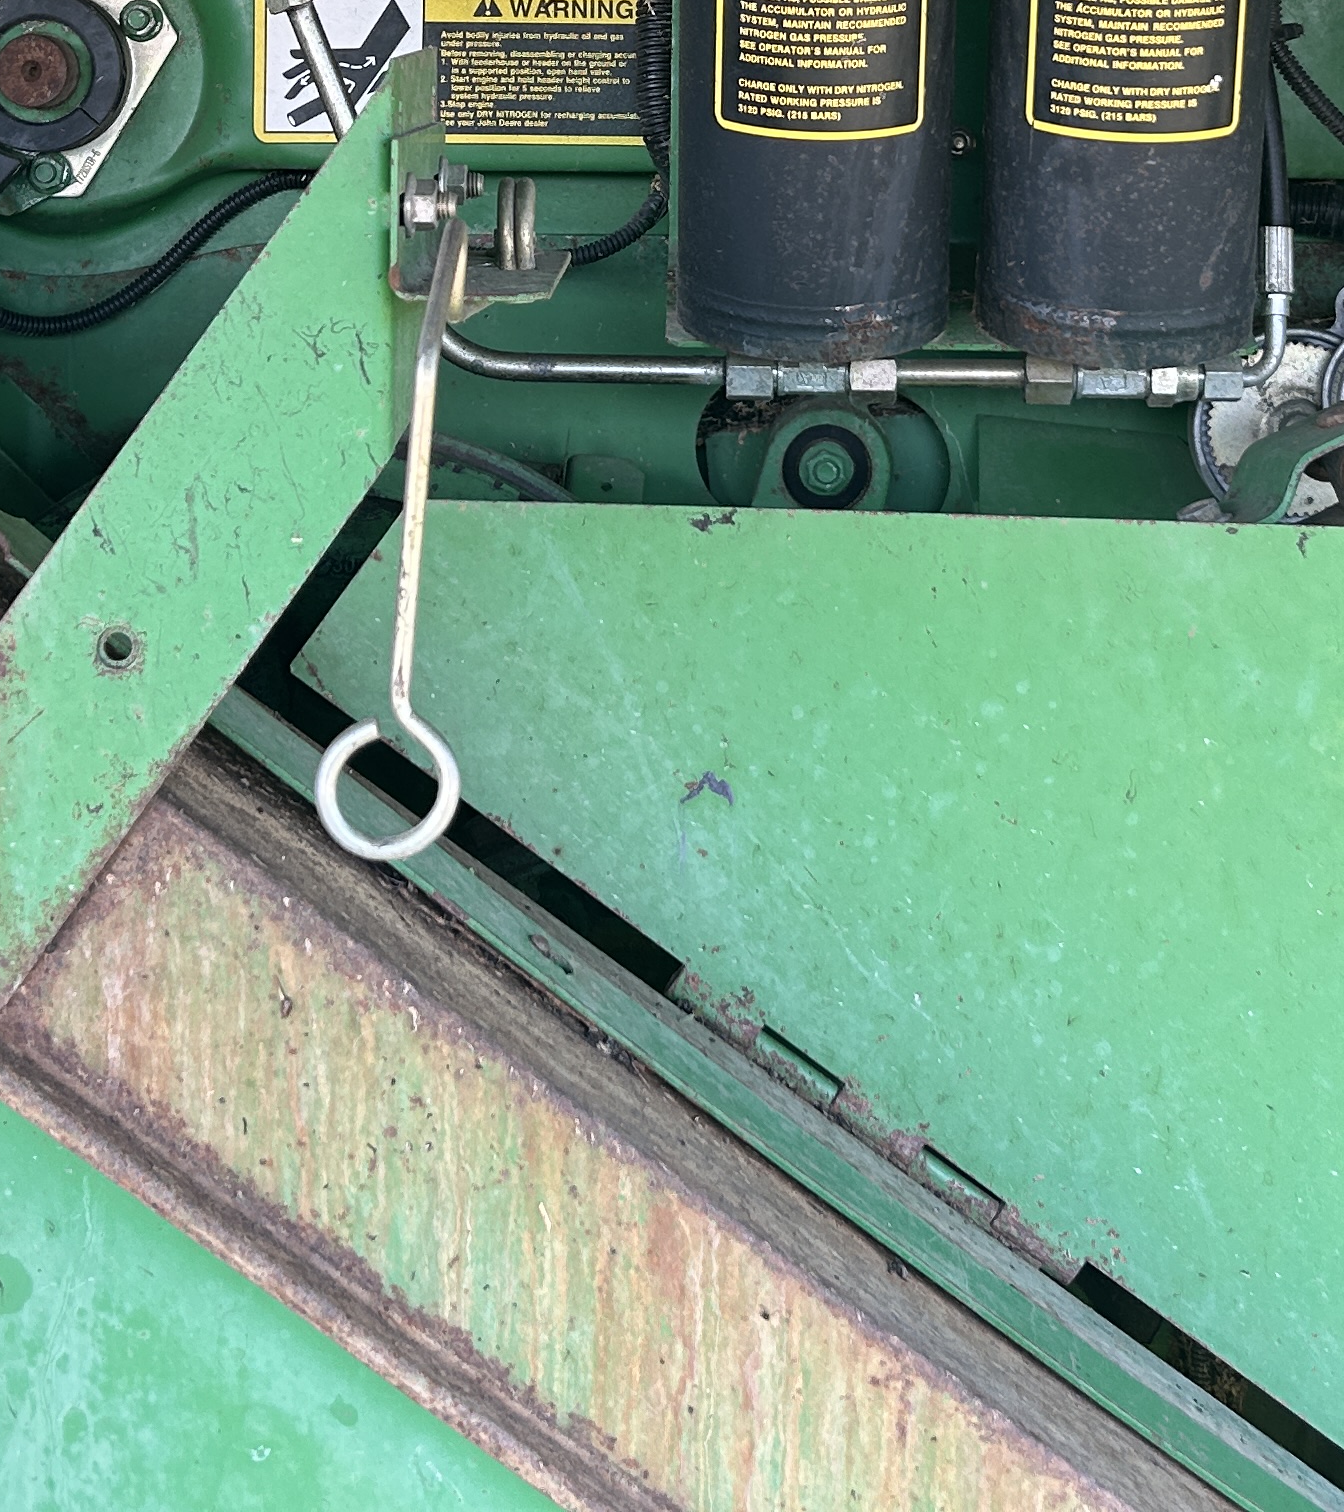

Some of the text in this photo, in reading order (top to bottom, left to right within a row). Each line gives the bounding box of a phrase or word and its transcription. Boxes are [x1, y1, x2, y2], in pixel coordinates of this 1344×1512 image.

[740, 0, 907, 17] THE ACCUMULATOR OR HYDRAULIC
[739, 14, 907, 30] SYSTEM, MAINTAIN RECOMMENDED
[440, 30, 463, 39] Avoid
[465, 30, 489, 40] bodily
[492, 32, 521, 41] injuries
[522, 32, 541, 40] from
[543, 32, 579, 43] hydraulic
[610, 34, 624, 42] gas
[739, 27, 867, 43] NITROGEN GAS PRESSURE.
[739, 39, 887, 56] SEE OPERATOR'S MANUAL FOR
[738, 52, 868, 69] ADDITIONAL INFORMATION.
[738, 78, 776, 92] CHARGE
[778, 83, 805, 93] ONLY
[807, 85, 835, 95] WITH
[834, 85, 855, 95] DRY
[738, 91, 882, 108] RATED WORKING PRESSURE IS
[760, 107, 785, 118] PSIG.
[810, 111, 842, 121] BARS)
[1050, 104, 1071, 115] 3120
[1125, 112, 1157, 123] BARS)
